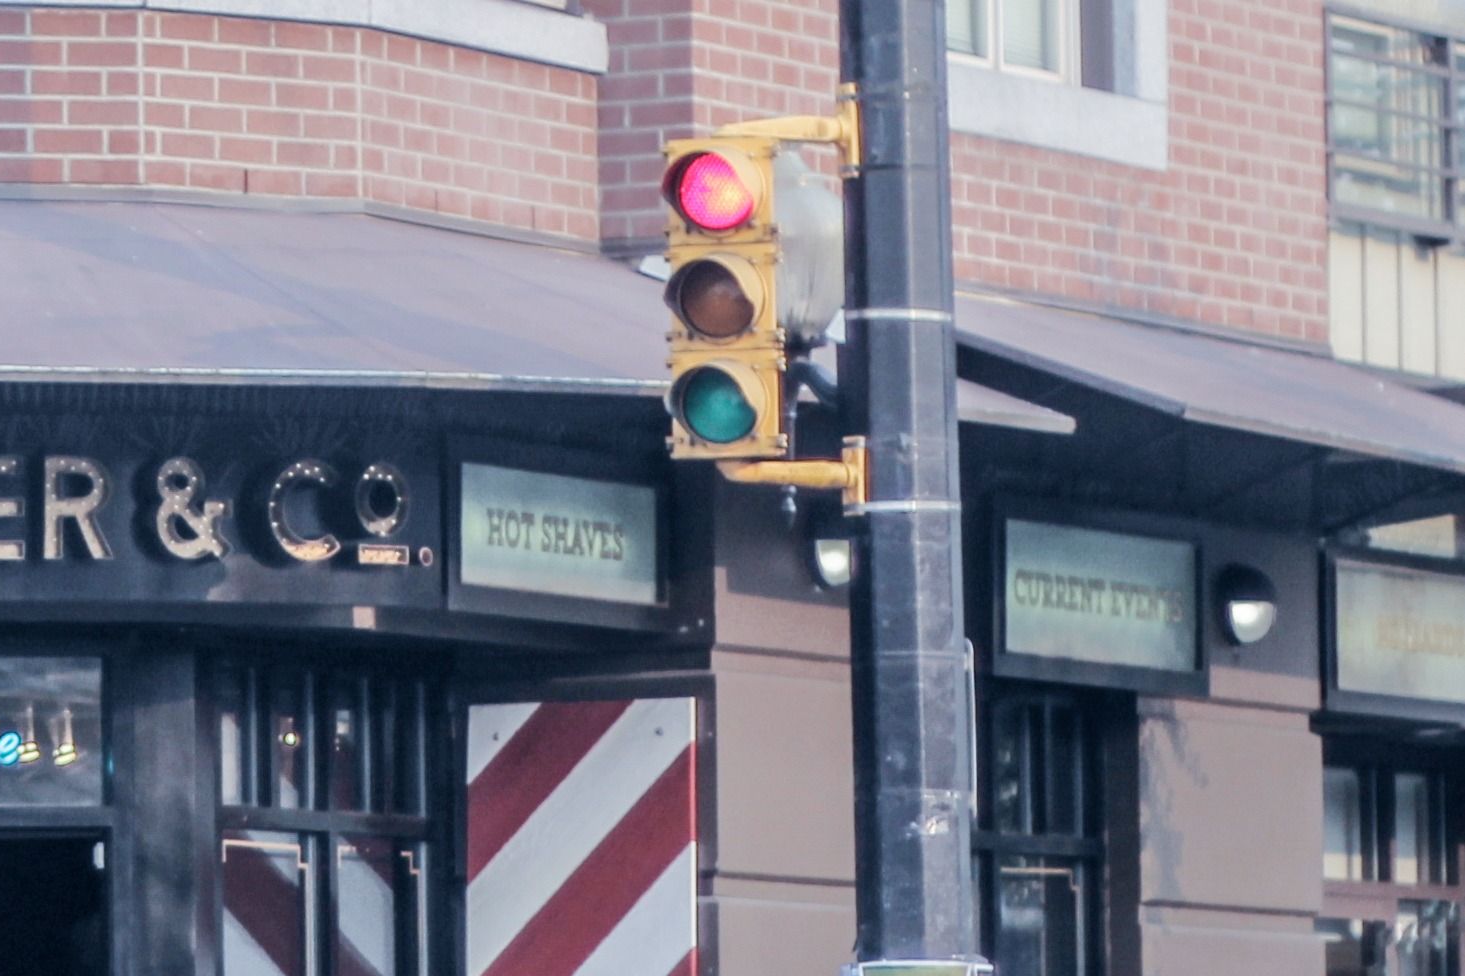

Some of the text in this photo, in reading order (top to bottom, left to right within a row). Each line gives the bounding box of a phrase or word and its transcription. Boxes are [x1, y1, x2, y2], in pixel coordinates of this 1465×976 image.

[156, 457, 234, 560] &
[486, 507, 625, 562] HOT SHAVES
[1014, 568, 1106, 616] CURRENT
